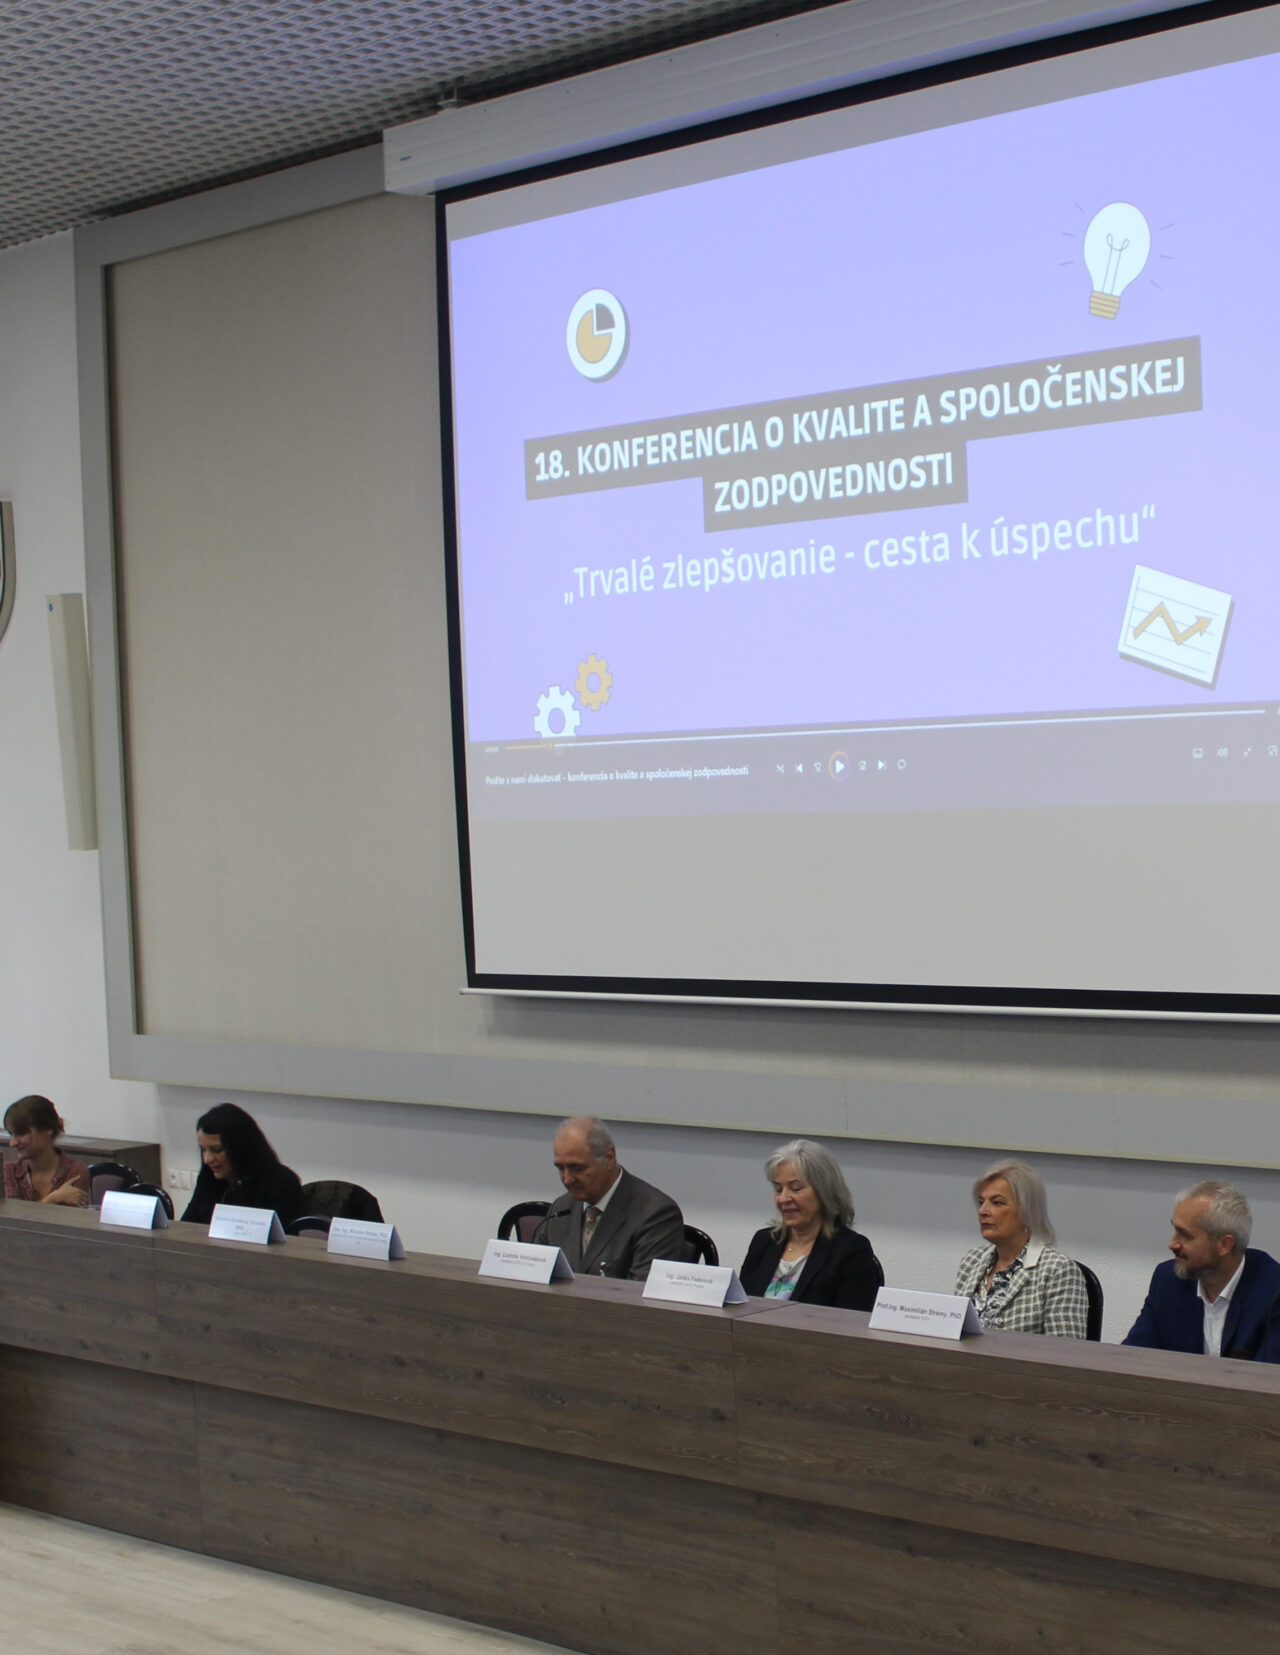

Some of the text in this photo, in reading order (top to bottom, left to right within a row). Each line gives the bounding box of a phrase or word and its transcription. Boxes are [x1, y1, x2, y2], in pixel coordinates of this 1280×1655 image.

[534, 356, 1185, 481] 18. KONFERENCIA O KVALITE A SPOLOČENSKEJ
[714, 452, 953, 512] ZODPOVEDNOSTI
[564, 555, 655, 605] „Trvalé
[662, 539, 836, 592] zlepšovanie
[864, 529, 950, 569] cesta
[961, 521, 981, 559] k
[990, 503, 1156, 560] úspechu“
